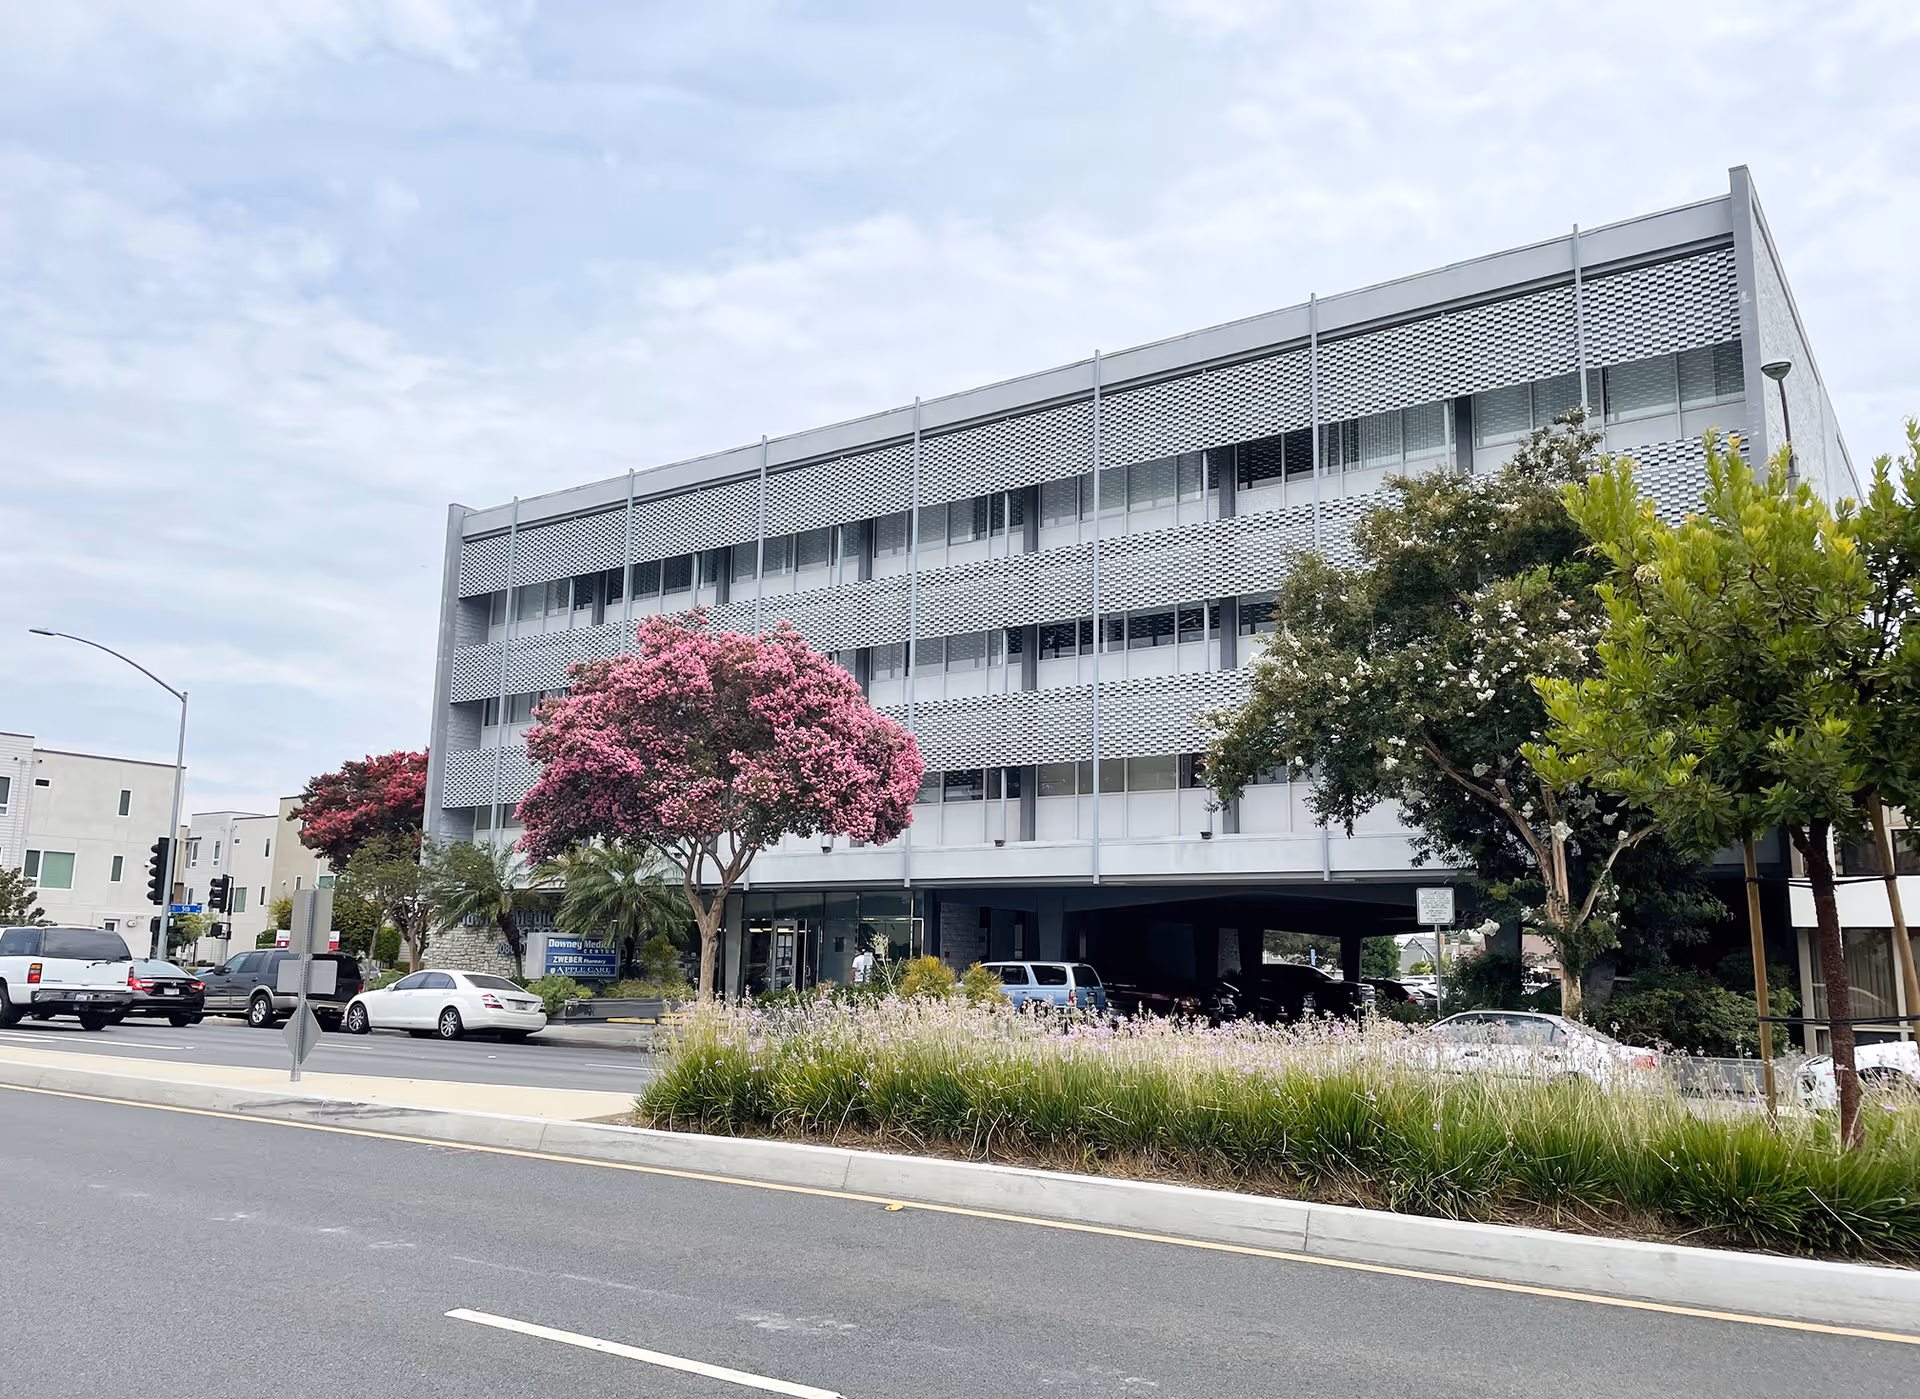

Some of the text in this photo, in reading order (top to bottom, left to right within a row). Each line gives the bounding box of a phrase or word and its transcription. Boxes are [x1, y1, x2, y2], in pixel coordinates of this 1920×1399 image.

[548, 938, 583, 950] Downey
[552, 955, 583, 964] ZWEBER
[557, 966, 587, 974] APPLE
